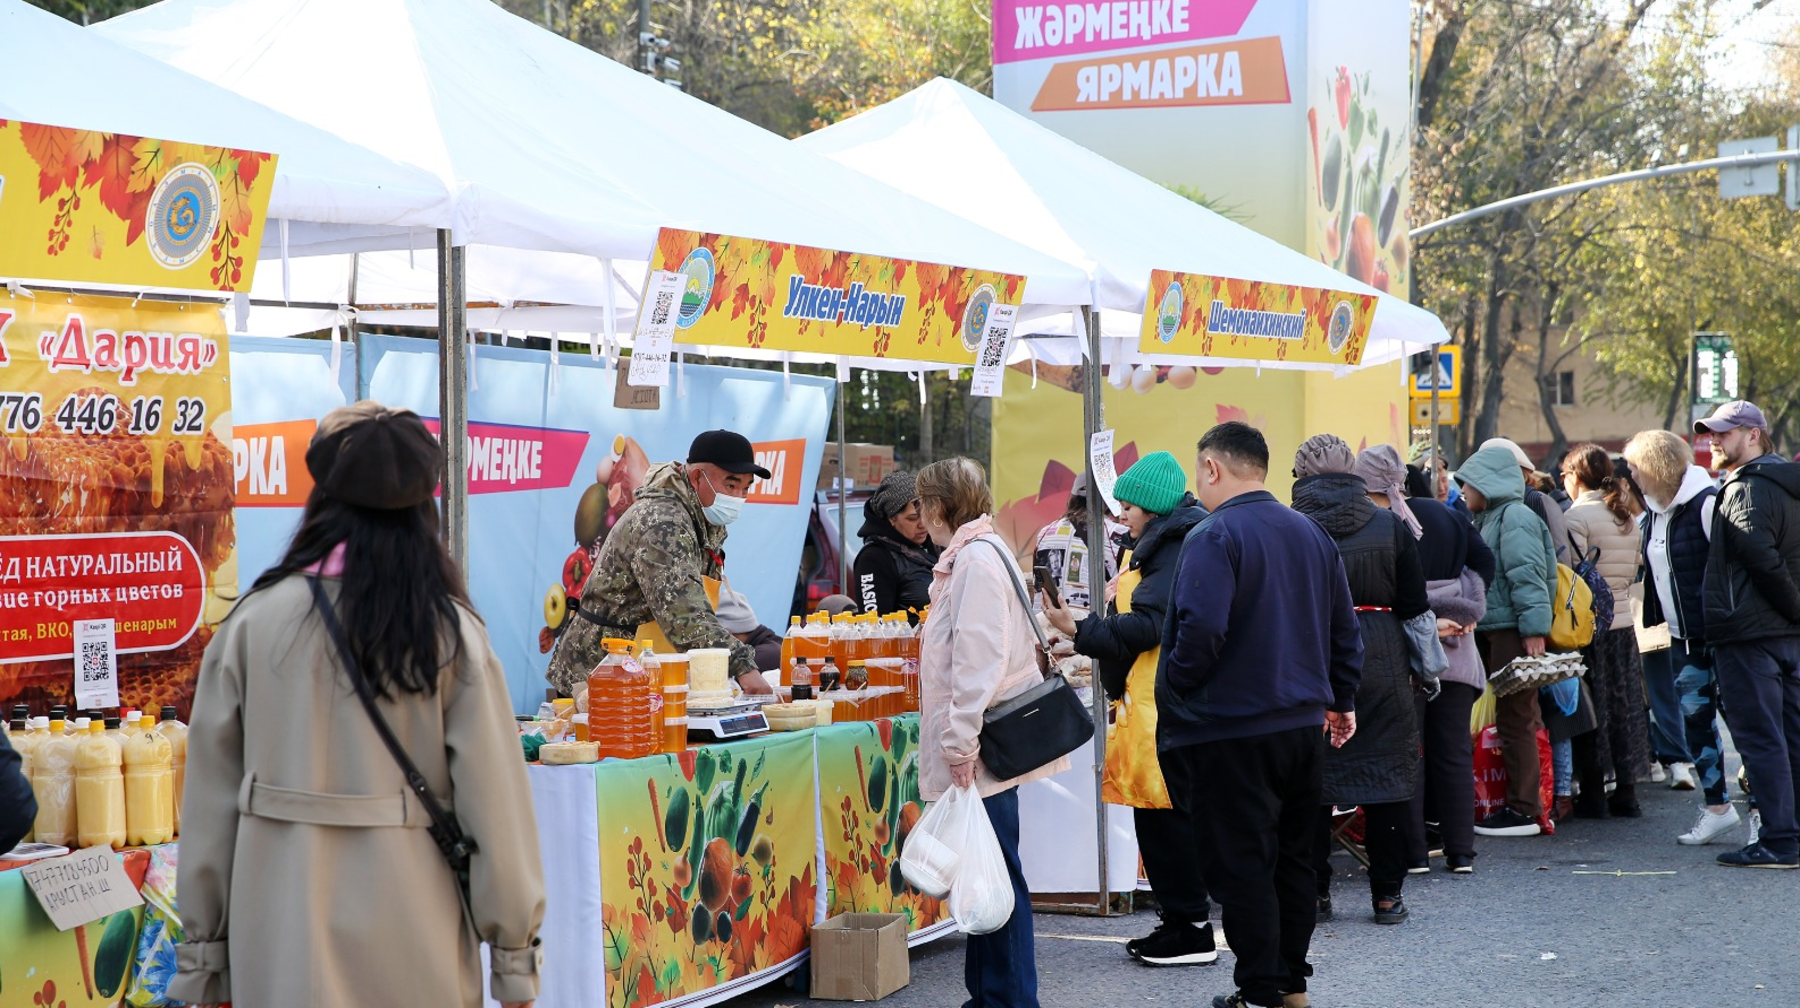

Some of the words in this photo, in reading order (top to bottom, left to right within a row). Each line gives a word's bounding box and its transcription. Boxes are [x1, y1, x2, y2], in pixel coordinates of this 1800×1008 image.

[1014, 0, 1190, 50] ЖӘРМЕҢКЕ
[1076, 51, 1243, 102] ЯРМАРКА
[783, 275, 906, 328] Улкен-Нарын
[1208, 300, 1306, 339] Шемонаихинский
[40, 317, 216, 382] «Дария»
[57, 397, 116, 432] 446
[131, 399, 161, 431] 16
[173, 400, 204, 432] 32
[467, 436, 543, 485] МЕҢКЕ
[26, 545, 183, 579] НАТУРАЛЬНЫЙ
[34, 587, 112, 611] горных
[116, 583, 183, 604] цветов
[36, 621, 72, 640] ВКО,
